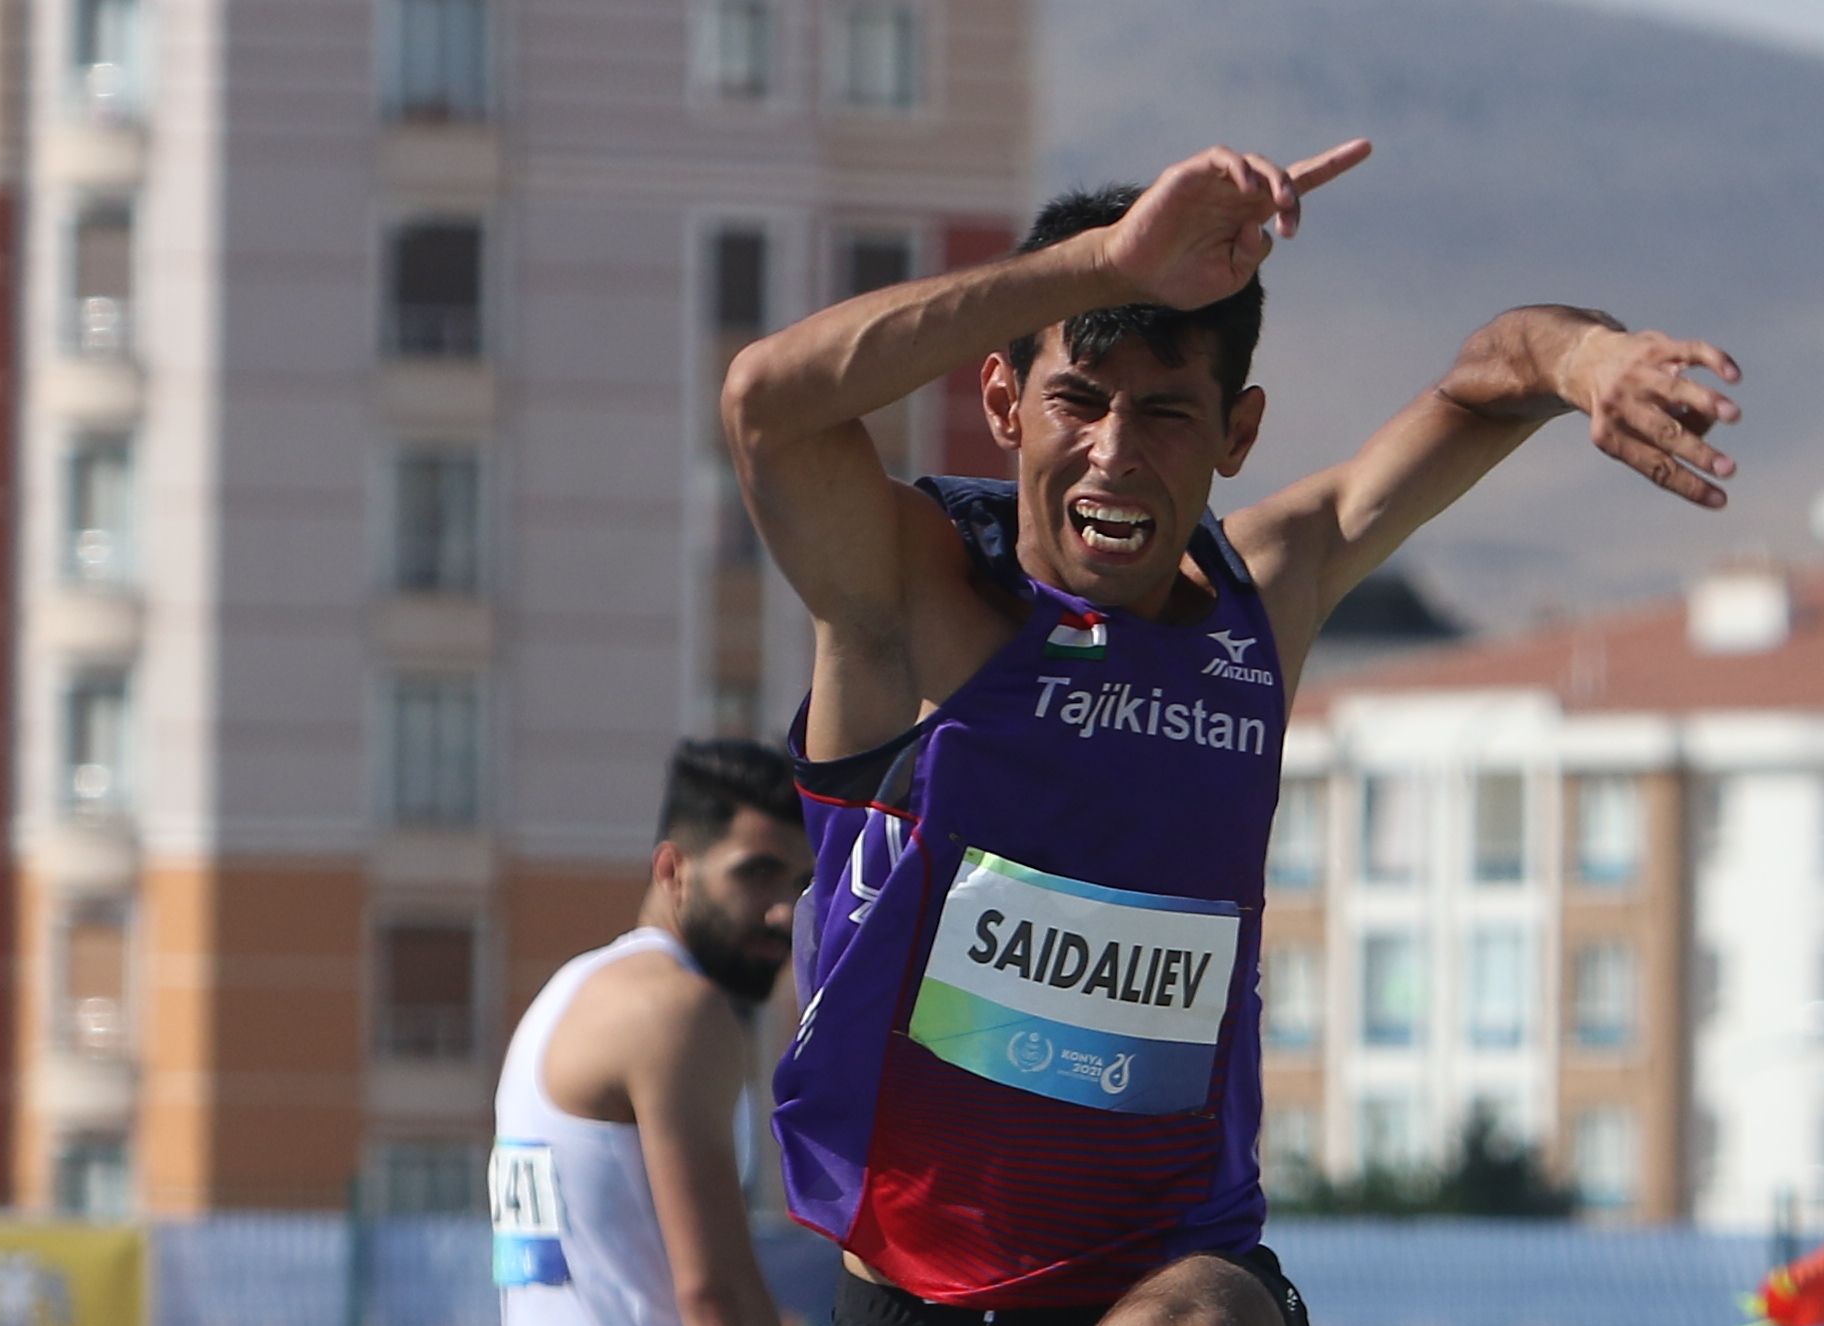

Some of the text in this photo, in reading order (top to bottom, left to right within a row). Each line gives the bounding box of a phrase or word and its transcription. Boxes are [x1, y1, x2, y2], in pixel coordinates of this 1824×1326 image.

[1201, 657, 1275, 686] MIZUNO
[1034, 675, 1266, 756] Tajikistan
[967, 908, 1213, 1009] SAIDALIEV
[1060, 1048, 1104, 1067] KONYA
[1072, 1062, 1103, 1077] 2021
[493, 1156, 541, 1224] 41
